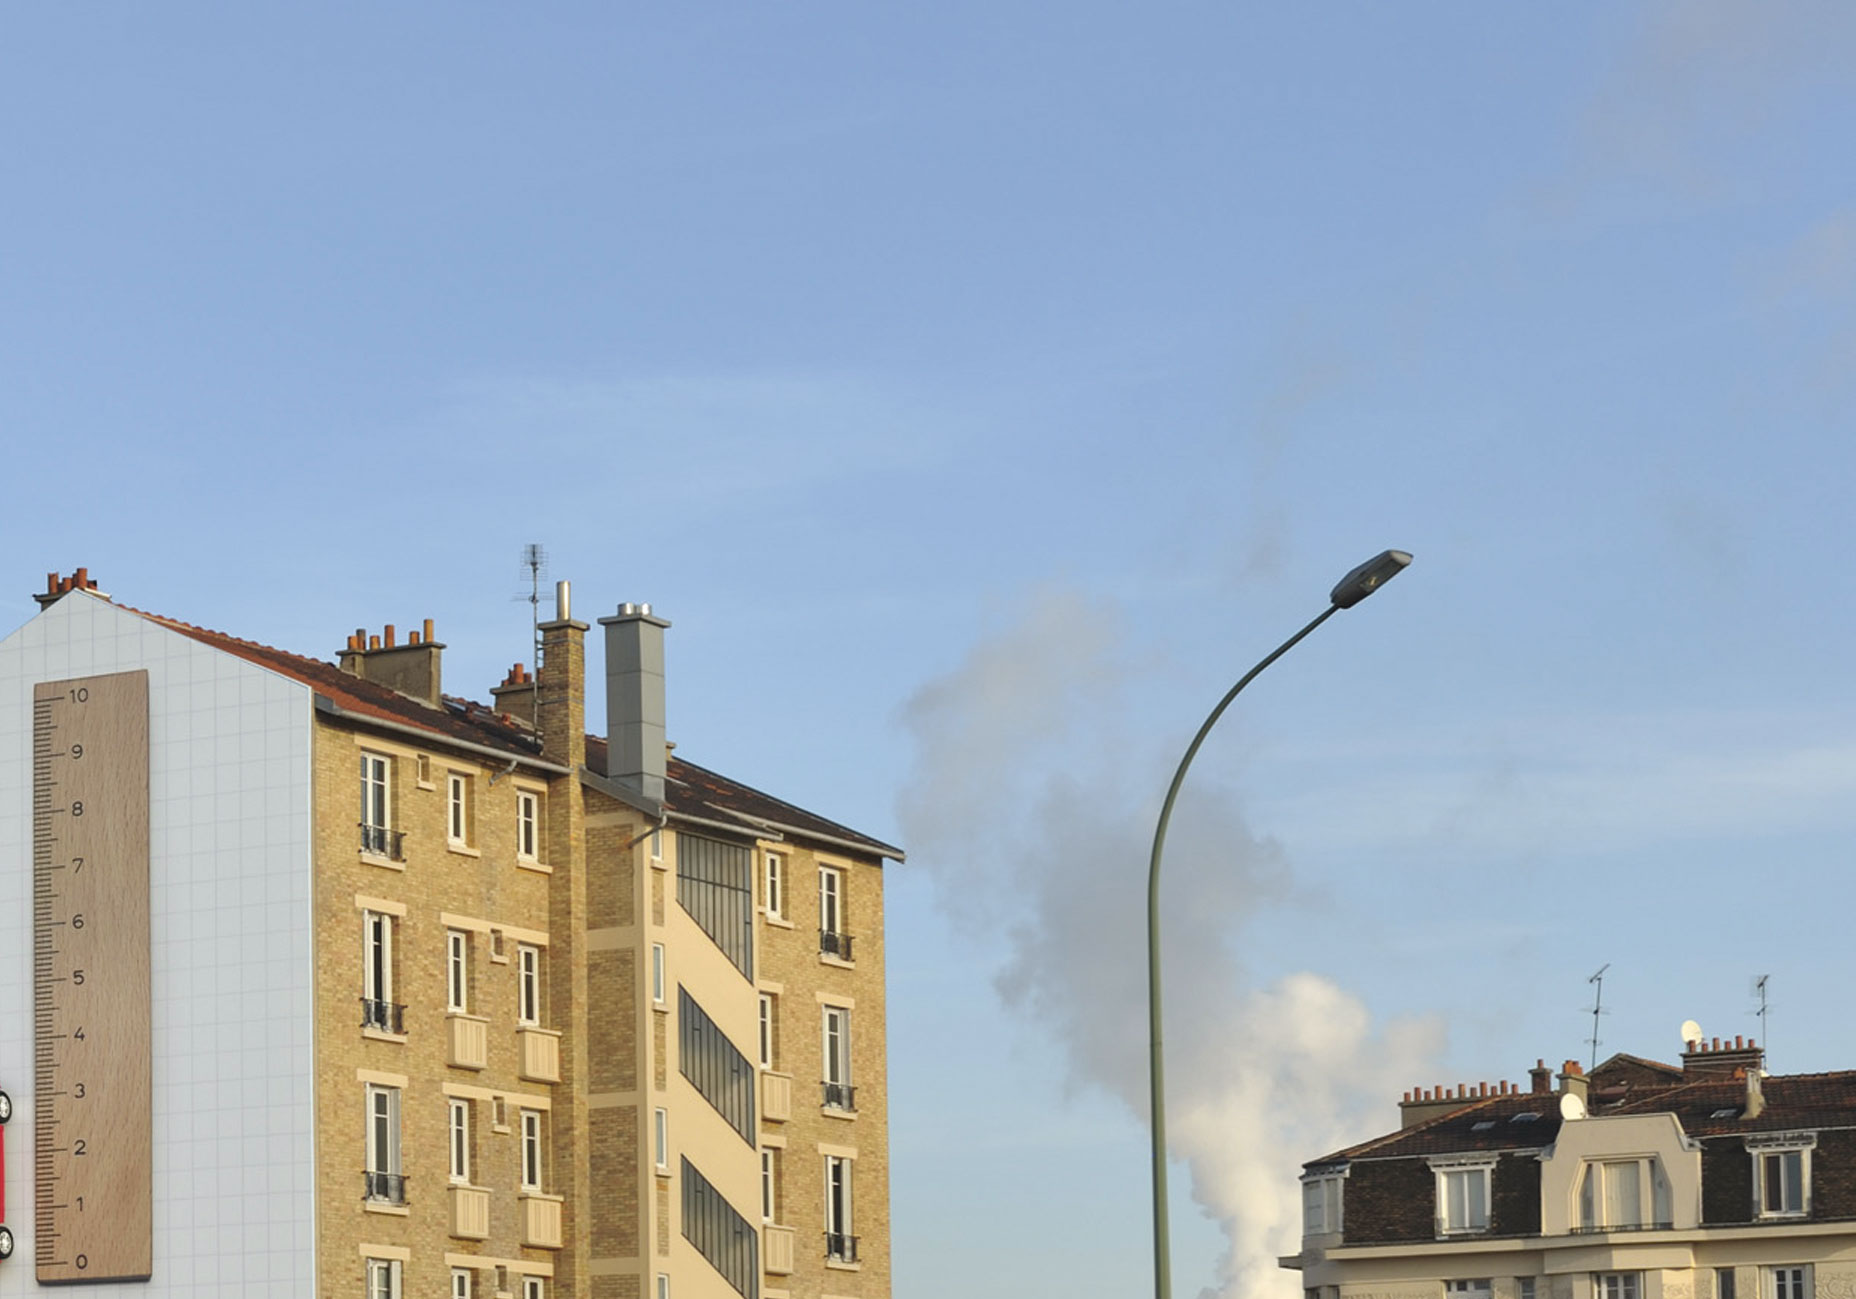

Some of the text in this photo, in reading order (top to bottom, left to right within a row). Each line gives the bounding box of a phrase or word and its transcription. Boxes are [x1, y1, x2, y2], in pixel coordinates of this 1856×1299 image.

[70, 688, 88, 703] 10
[72, 744, 84, 759] 9
[72, 801, 84, 816] 8
[72, 857, 84, 873] 7
[72, 914, 84, 929] 6
[73, 970, 85, 985] 5
[73, 1026, 85, 1041] 4
[74, 1083, 86, 1098] 3
[74, 1140, 86, 1155] 2
[76, 1196, 83, 1212] 1
[75, 1254, 88, 1269] 0
